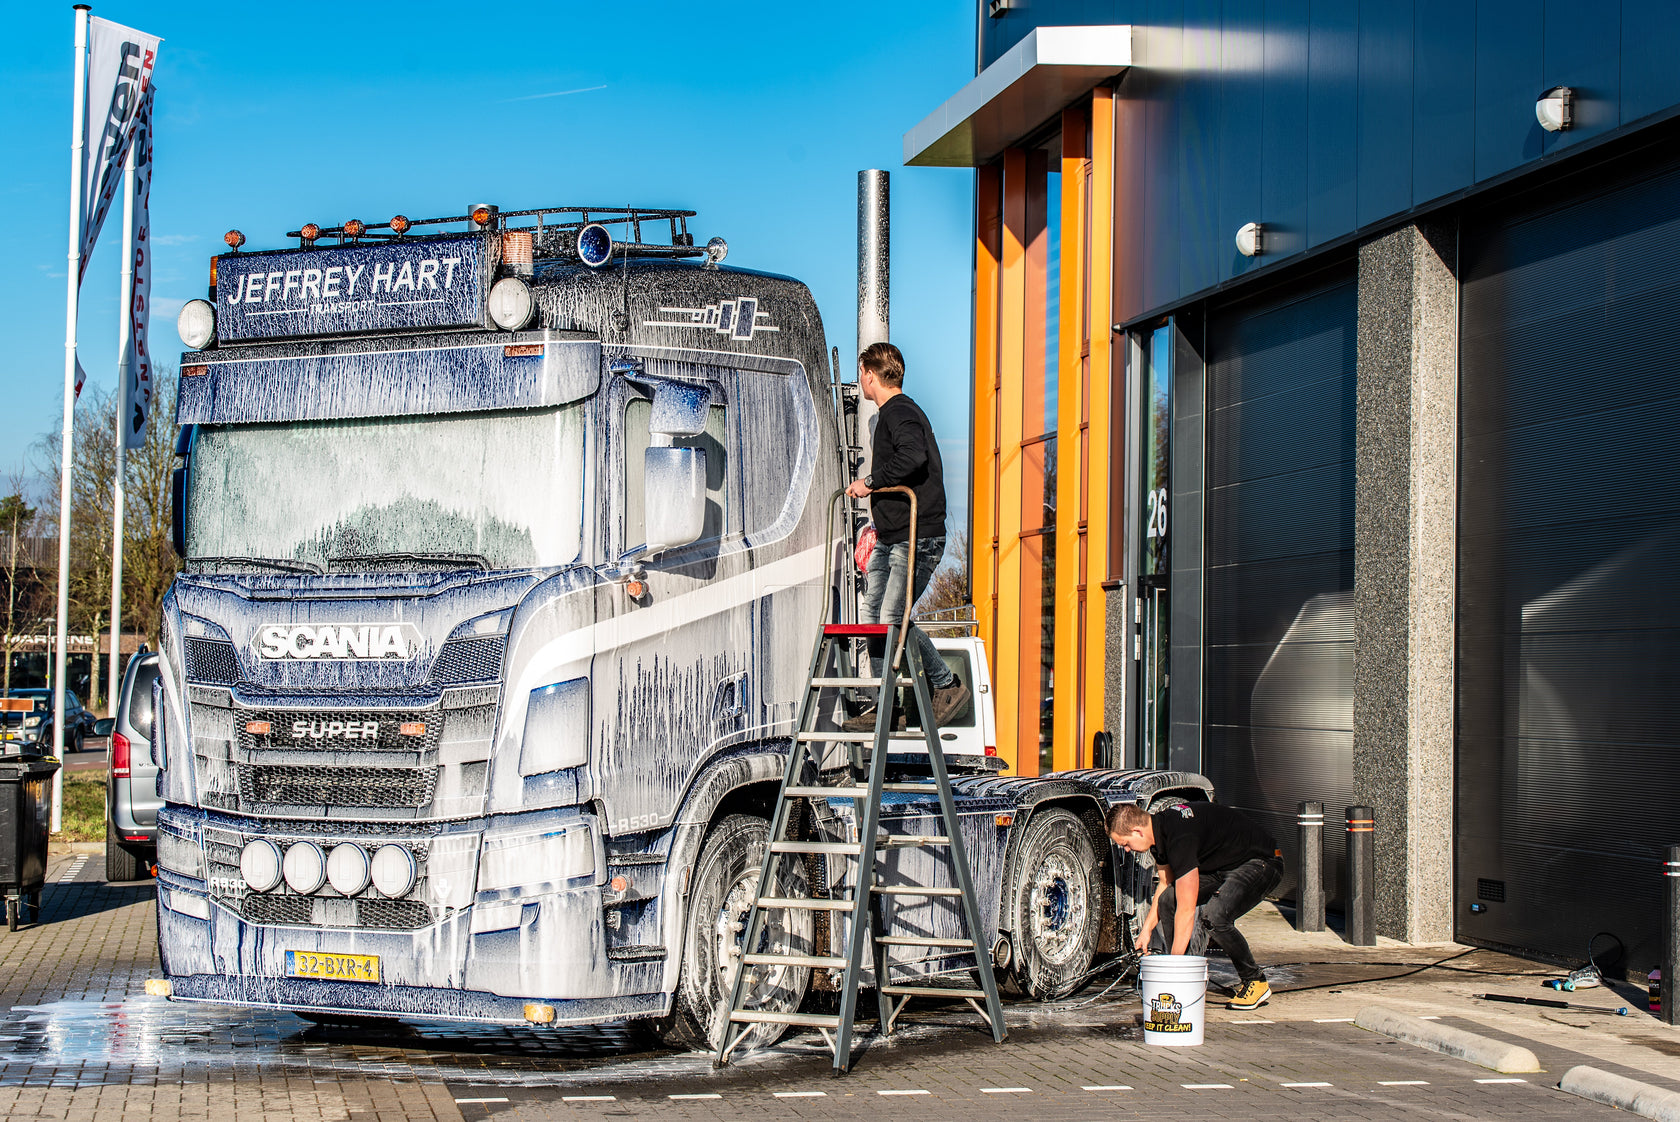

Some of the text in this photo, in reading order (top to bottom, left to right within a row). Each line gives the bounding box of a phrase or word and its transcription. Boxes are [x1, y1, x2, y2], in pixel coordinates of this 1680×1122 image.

[228, 257, 462, 305] JEFFREY HART
[309, 299, 375, 315] TRANSPORT
[1147, 487, 1167, 538] 26
[261, 626, 410, 659] SCANIA
[291, 721, 379, 740] SUPER
[617, 812, 658, 833] R530
[299, 955, 373, 978] 32-BXR-4
